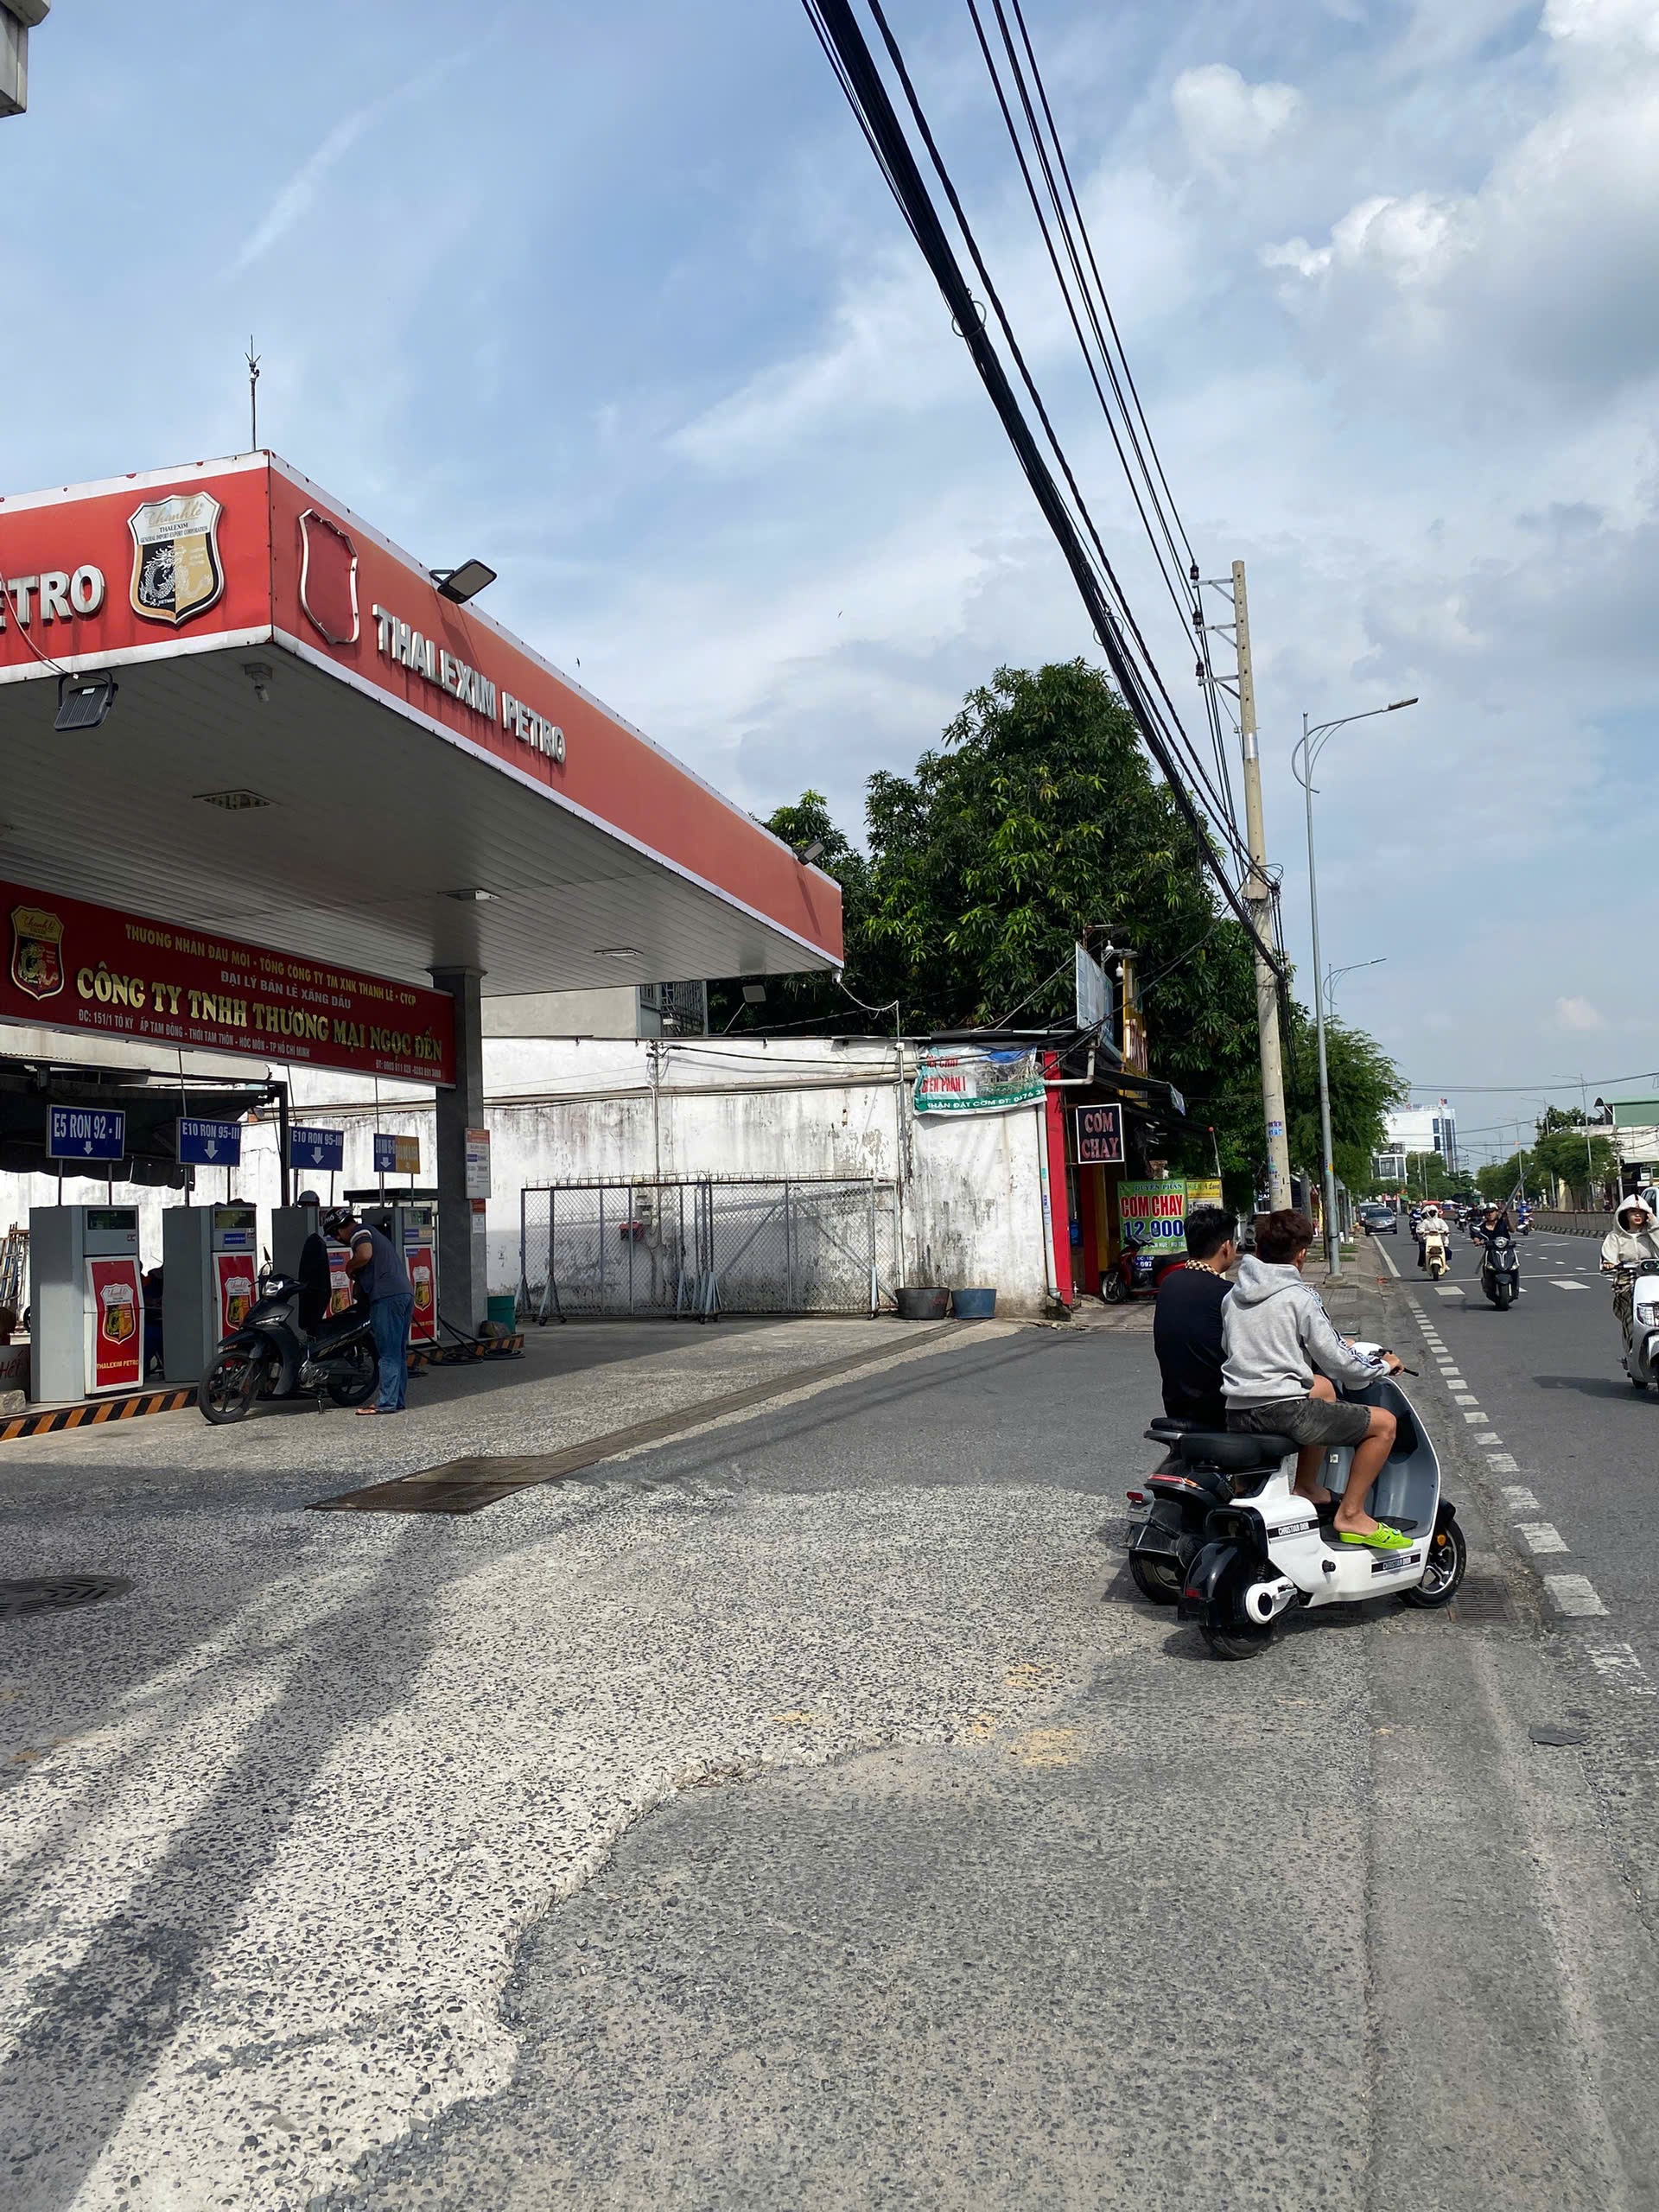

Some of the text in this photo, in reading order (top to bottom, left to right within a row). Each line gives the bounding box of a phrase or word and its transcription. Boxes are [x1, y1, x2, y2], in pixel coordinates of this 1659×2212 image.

[159, 523, 188, 532] THALEXIM
[0, 564, 105, 631] TRO
[372, 603, 566, 764] THALEXIM PETRO
[220, 969, 241, 987] ĐẠI
[244, 974, 257, 989] LÝ
[260, 978, 283, 995] BÁN
[314, 970, 324, 985] TY
[326, 974, 339, 989] TM
[340, 976, 357, 994] XNK
[359, 982, 385, 1000] THANH
[77, 961, 146, 1009] CÔNG
[151, 982, 183, 1015] TY
[188, 989, 248, 1028] TNHH
[252, 1002, 329, 1042] THƯƠNG
[333, 1019, 365, 1053] MẠI
[370, 1026, 411, 1062] NGỌC
[79, 1008, 92, 1023] ĐC:
[93, 1011, 112, 1027] 151/1
[150, 1021, 164, 1034] TAM
[54, 1113, 67, 1139] E5
[70, 1114, 91, 1139] RON
[93, 1115, 106, 1140] 92
[182, 1122, 199, 1136] E10
[200, 1123, 216, 1138] RON
[1084, 1109, 1114, 1134] CƠM
[292, 1129, 306, 1144] E10
[308, 1132, 323, 1146] RON
[1081, 1137, 1119, 1159] CHAY
[1120, 1192, 1149, 1218] CƠM
[1151, 1194, 1183, 1217] CHAY
